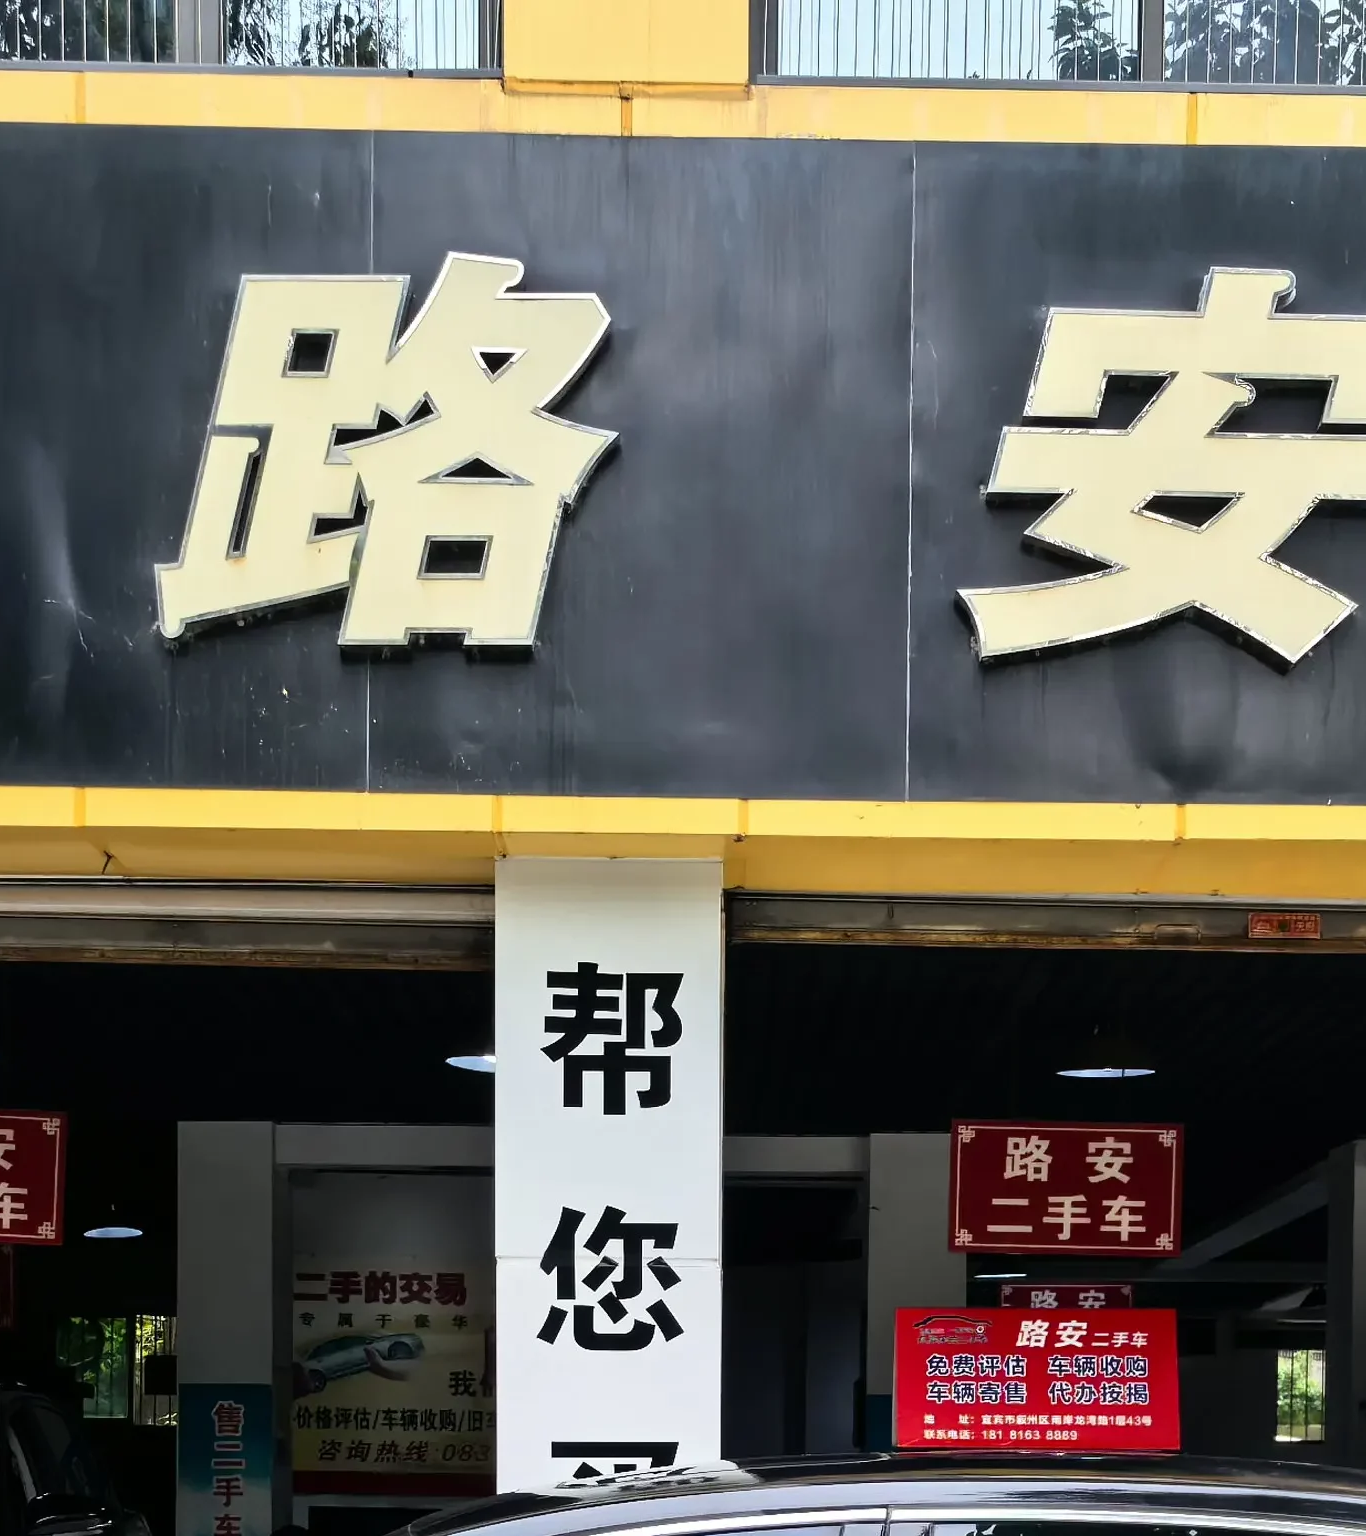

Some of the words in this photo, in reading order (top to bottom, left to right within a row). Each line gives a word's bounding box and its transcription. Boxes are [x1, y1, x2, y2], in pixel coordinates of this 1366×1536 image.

[1004, 1135, 1134, 1184] 路安
[987, 1194, 1147, 1242] 二手车
[293, 1271, 468, 1305] 二手的交易
[925, 1354, 1027, 1377] 免费评估
[1048, 1354, 1149, 1377] 车辆收购
[926, 1381, 1027, 1405] 车辆寄售
[1048, 1381, 1149, 1405] 代办按揭
